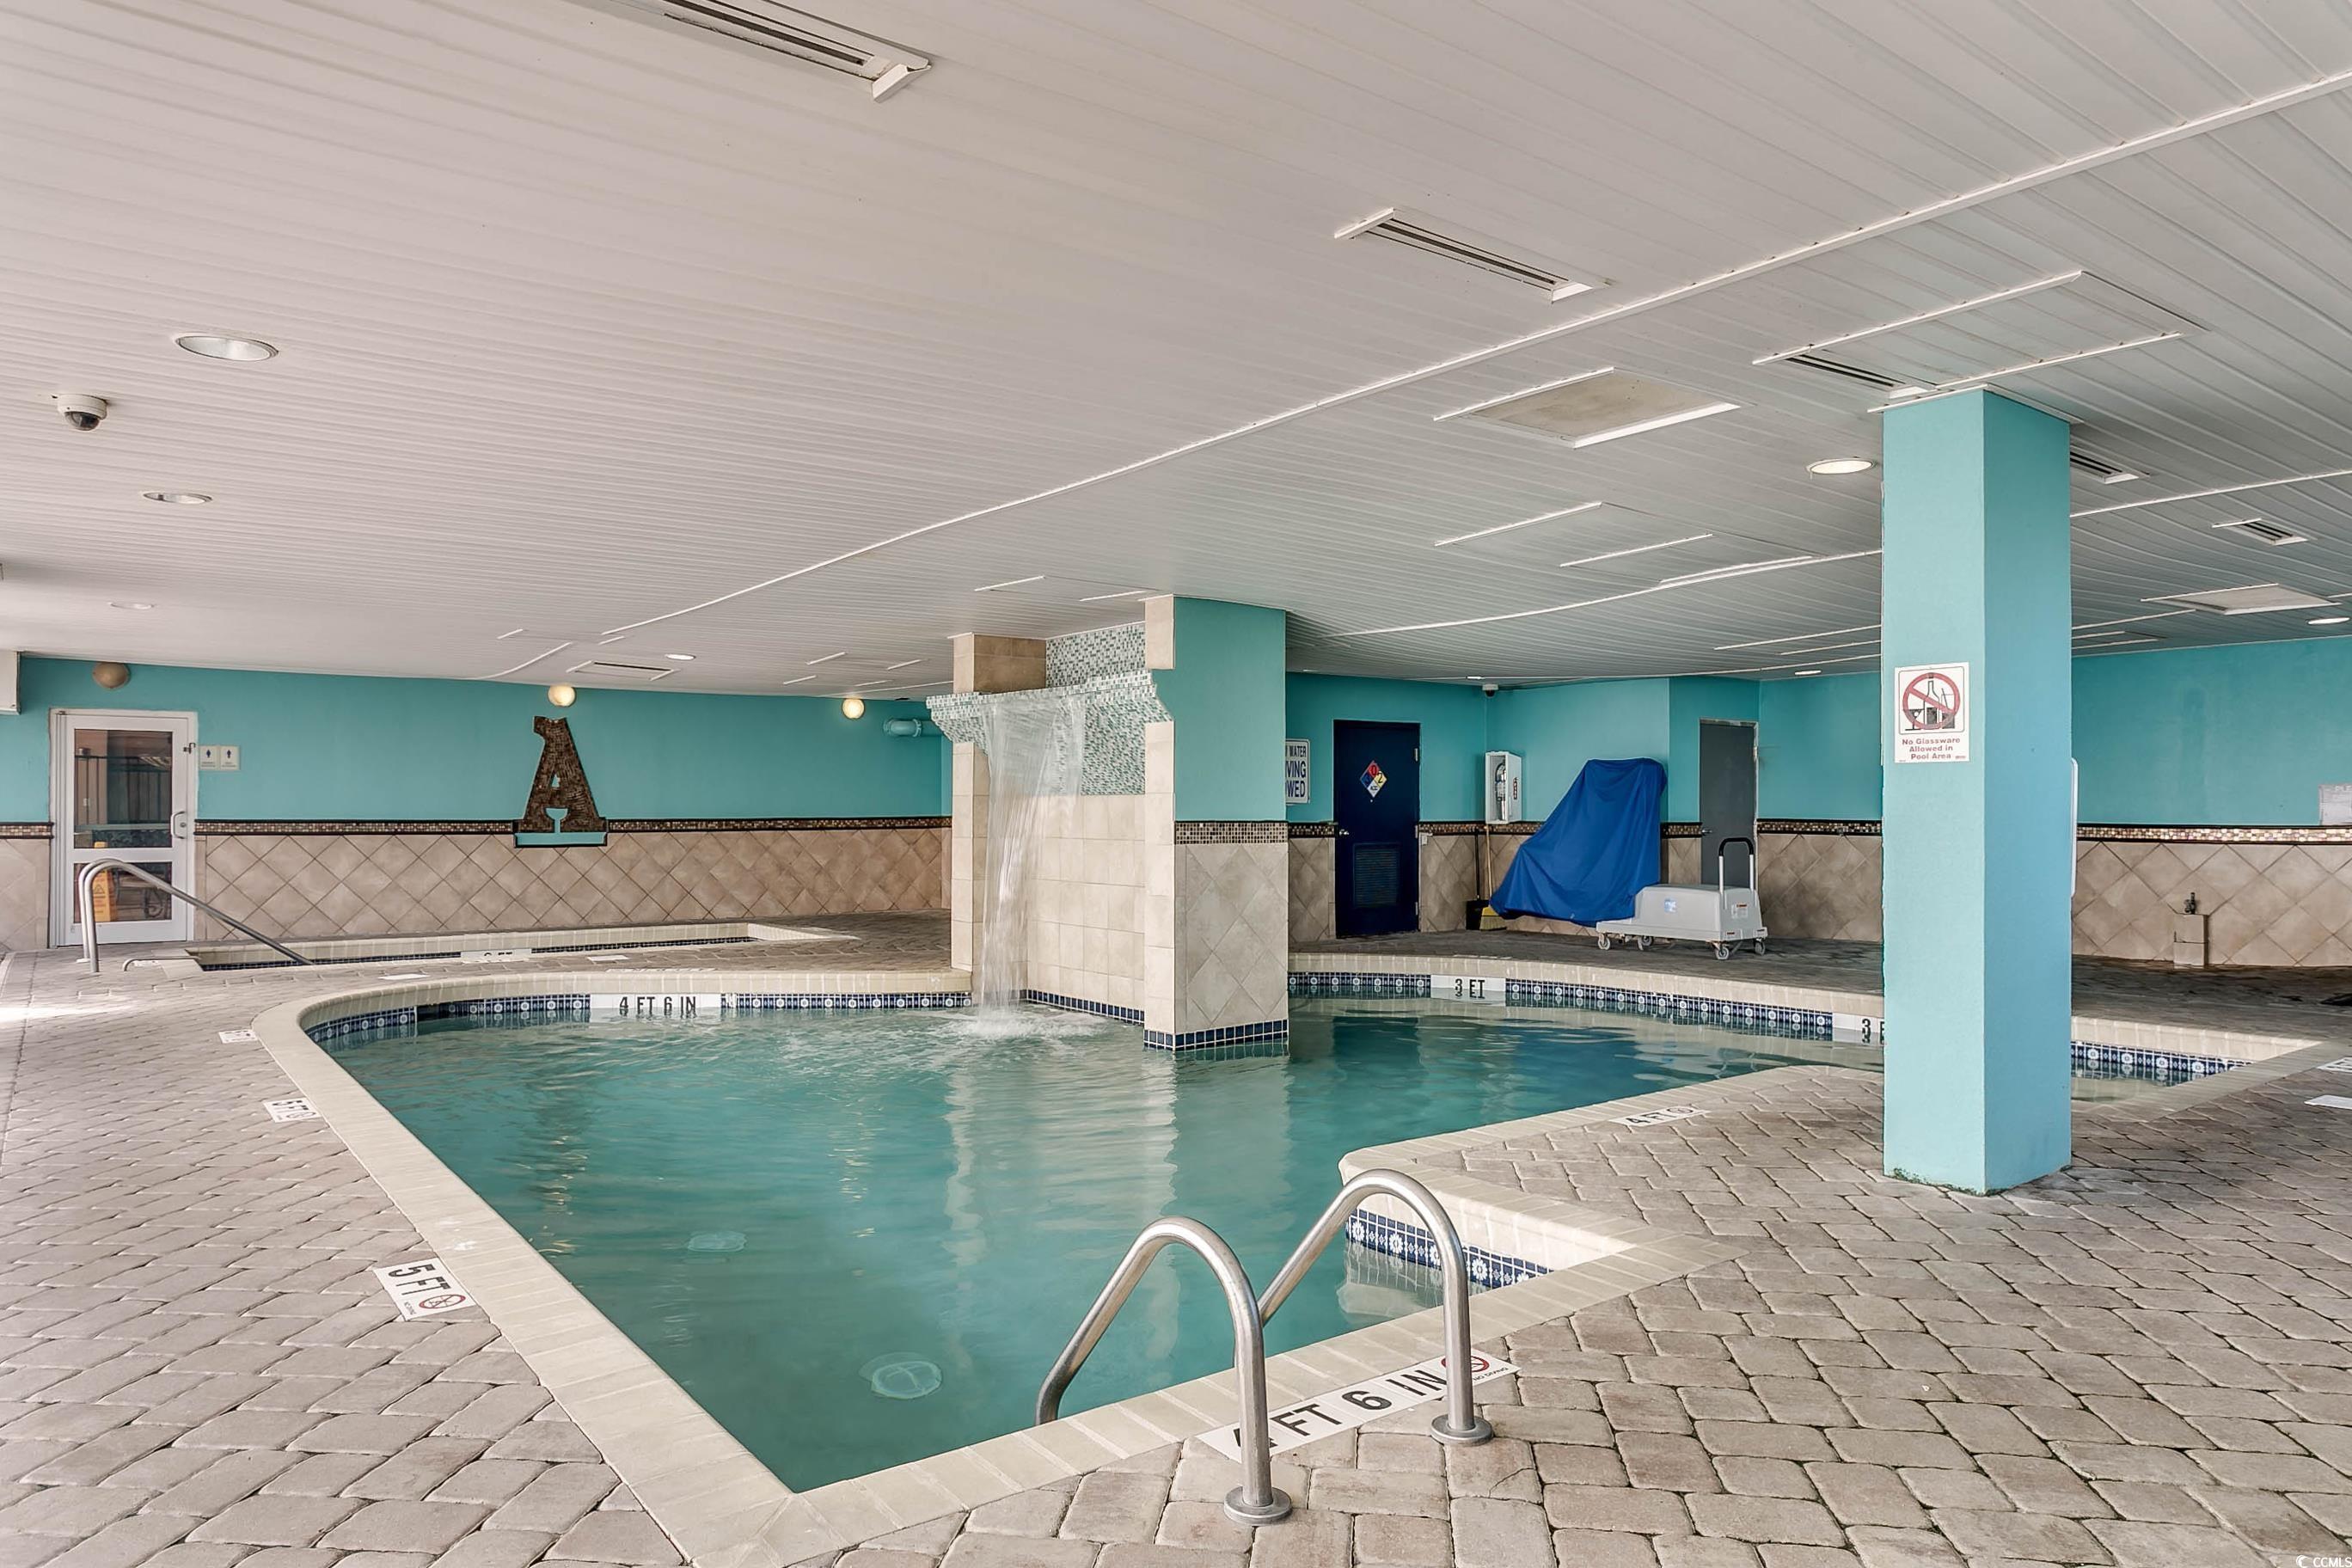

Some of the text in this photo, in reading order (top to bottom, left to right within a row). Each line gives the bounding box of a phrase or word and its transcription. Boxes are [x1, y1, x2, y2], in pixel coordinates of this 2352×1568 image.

[1289, 745, 1307, 757] WATER
[619, 996, 629, 1008] 4
[664, 996, 672, 1010] 6
[389, 1264, 451, 1295] 5 FT
[1270, 1369, 1448, 1436] FT 6 IN
